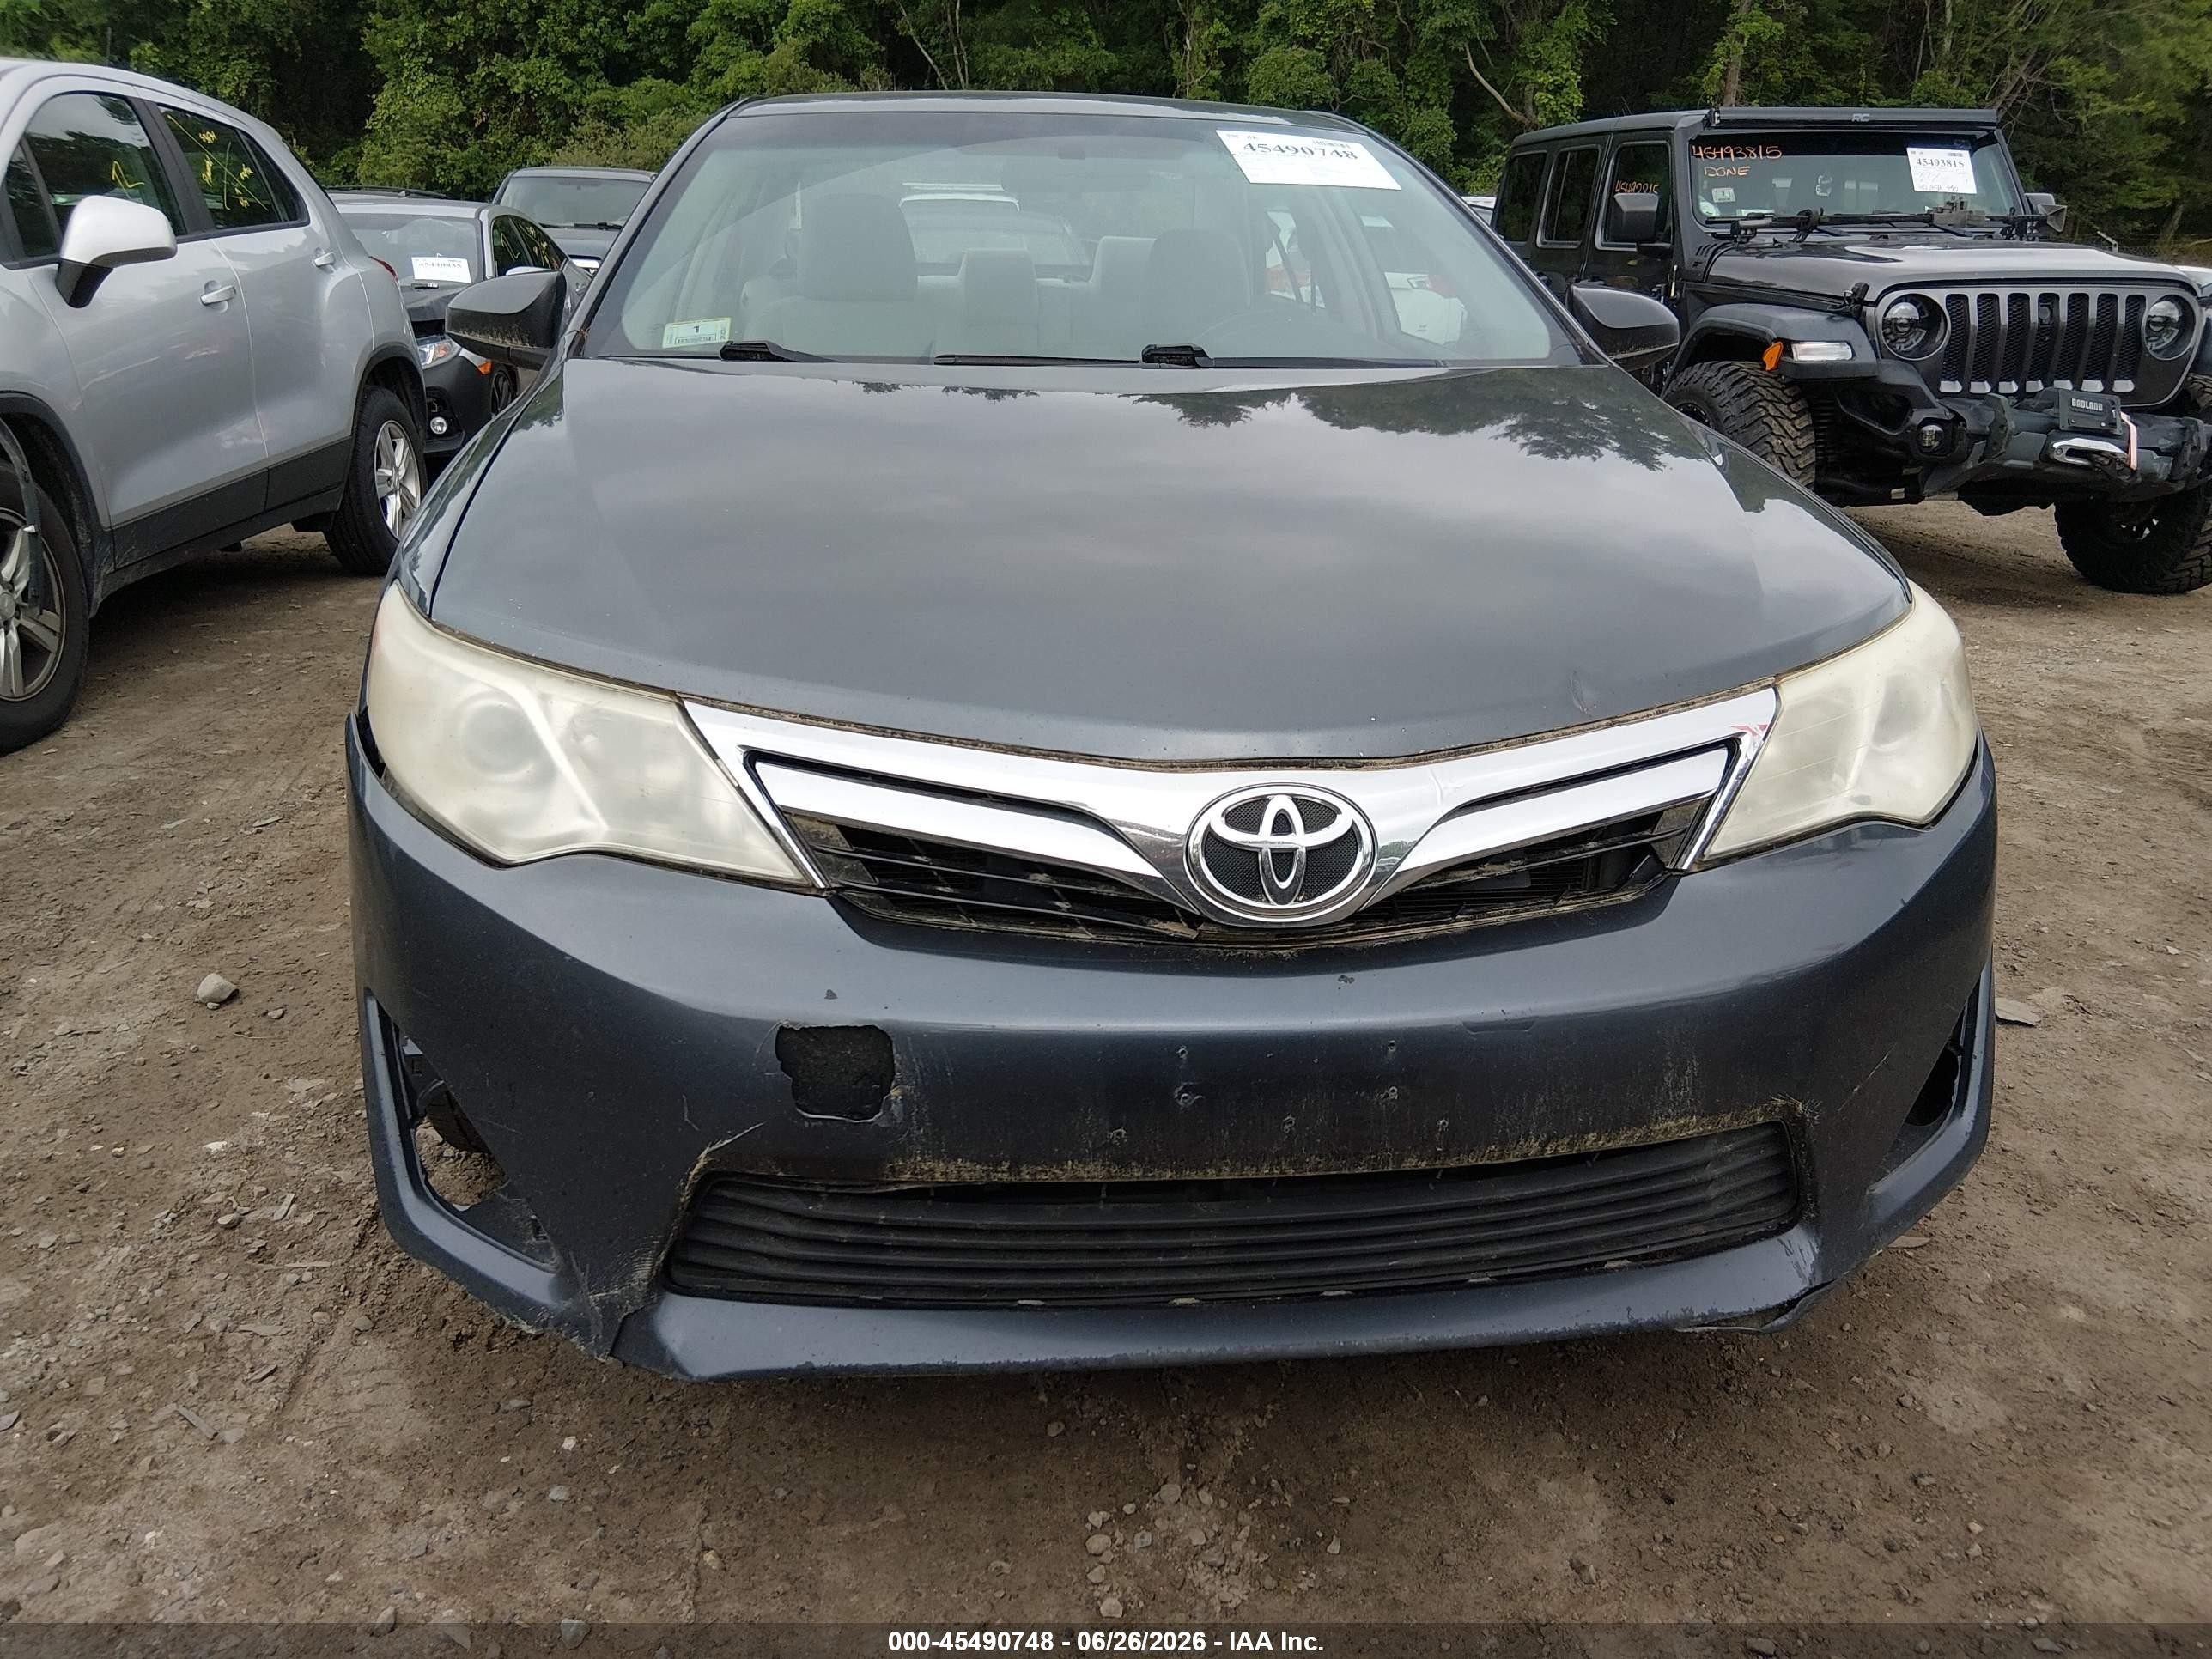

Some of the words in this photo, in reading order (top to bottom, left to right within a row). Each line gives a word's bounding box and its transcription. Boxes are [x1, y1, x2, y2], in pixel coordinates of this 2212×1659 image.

[1243, 142, 1358, 160] 45490748
[1692, 144, 1783, 161] 45493815
[1916, 158, 1965, 168] 45493815
[1704, 166, 1752, 177] DONE
[2071, 398, 2103, 412] BADLAND
